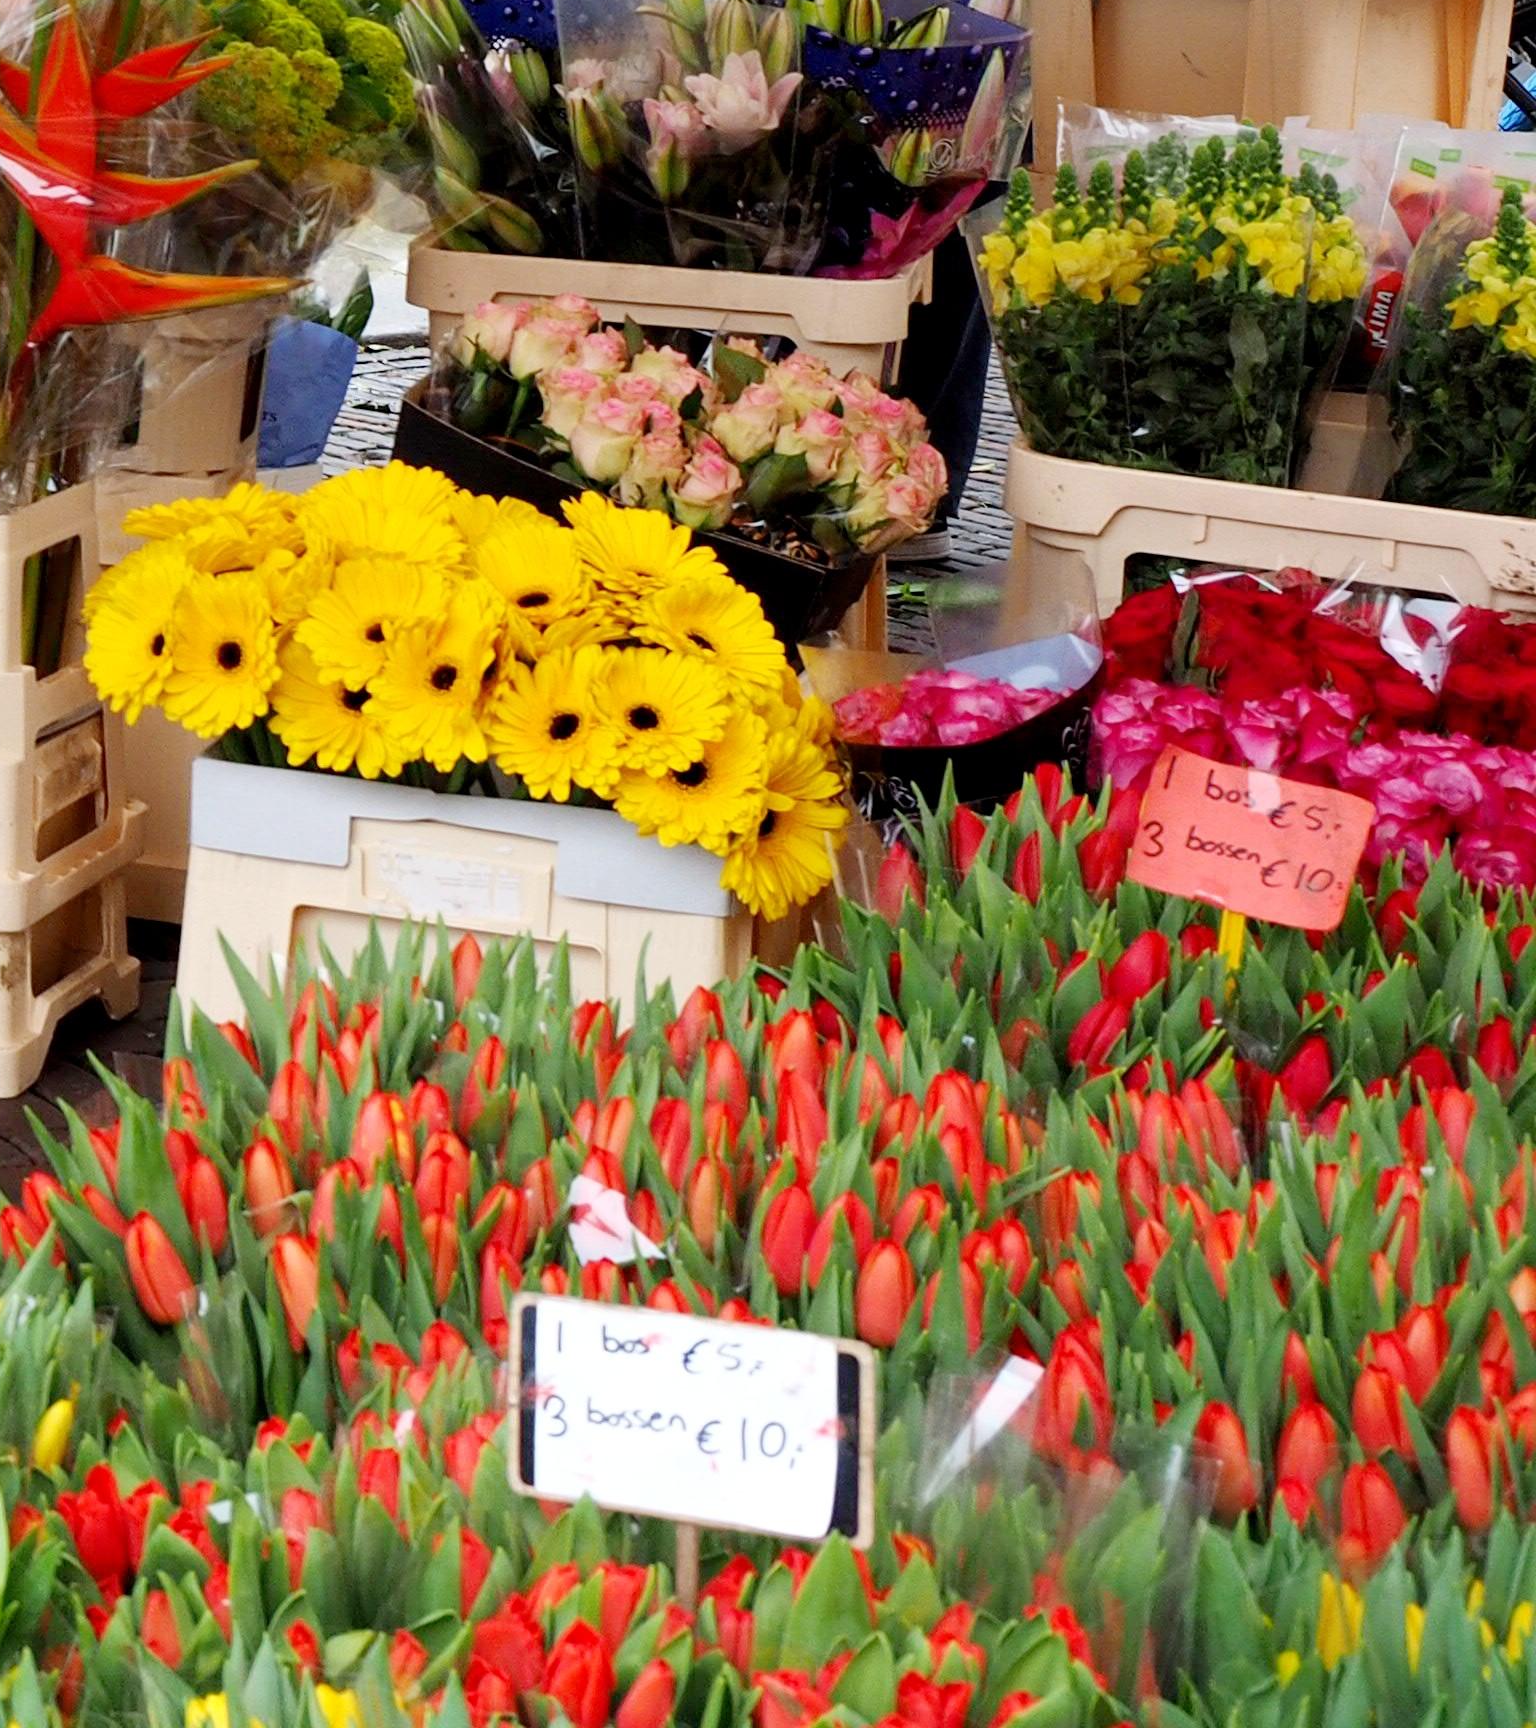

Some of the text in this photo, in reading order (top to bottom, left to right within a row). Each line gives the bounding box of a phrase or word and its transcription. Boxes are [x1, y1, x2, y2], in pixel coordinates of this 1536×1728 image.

[1204, 769, 1258, 808] bos
[1142, 820, 1165, 858] 3
[1185, 825, 1261, 864] bossen
[602, 1324, 650, 1354] bos
[542, 1395, 568, 1437] 3
[587, 1397, 687, 1432] bossen
